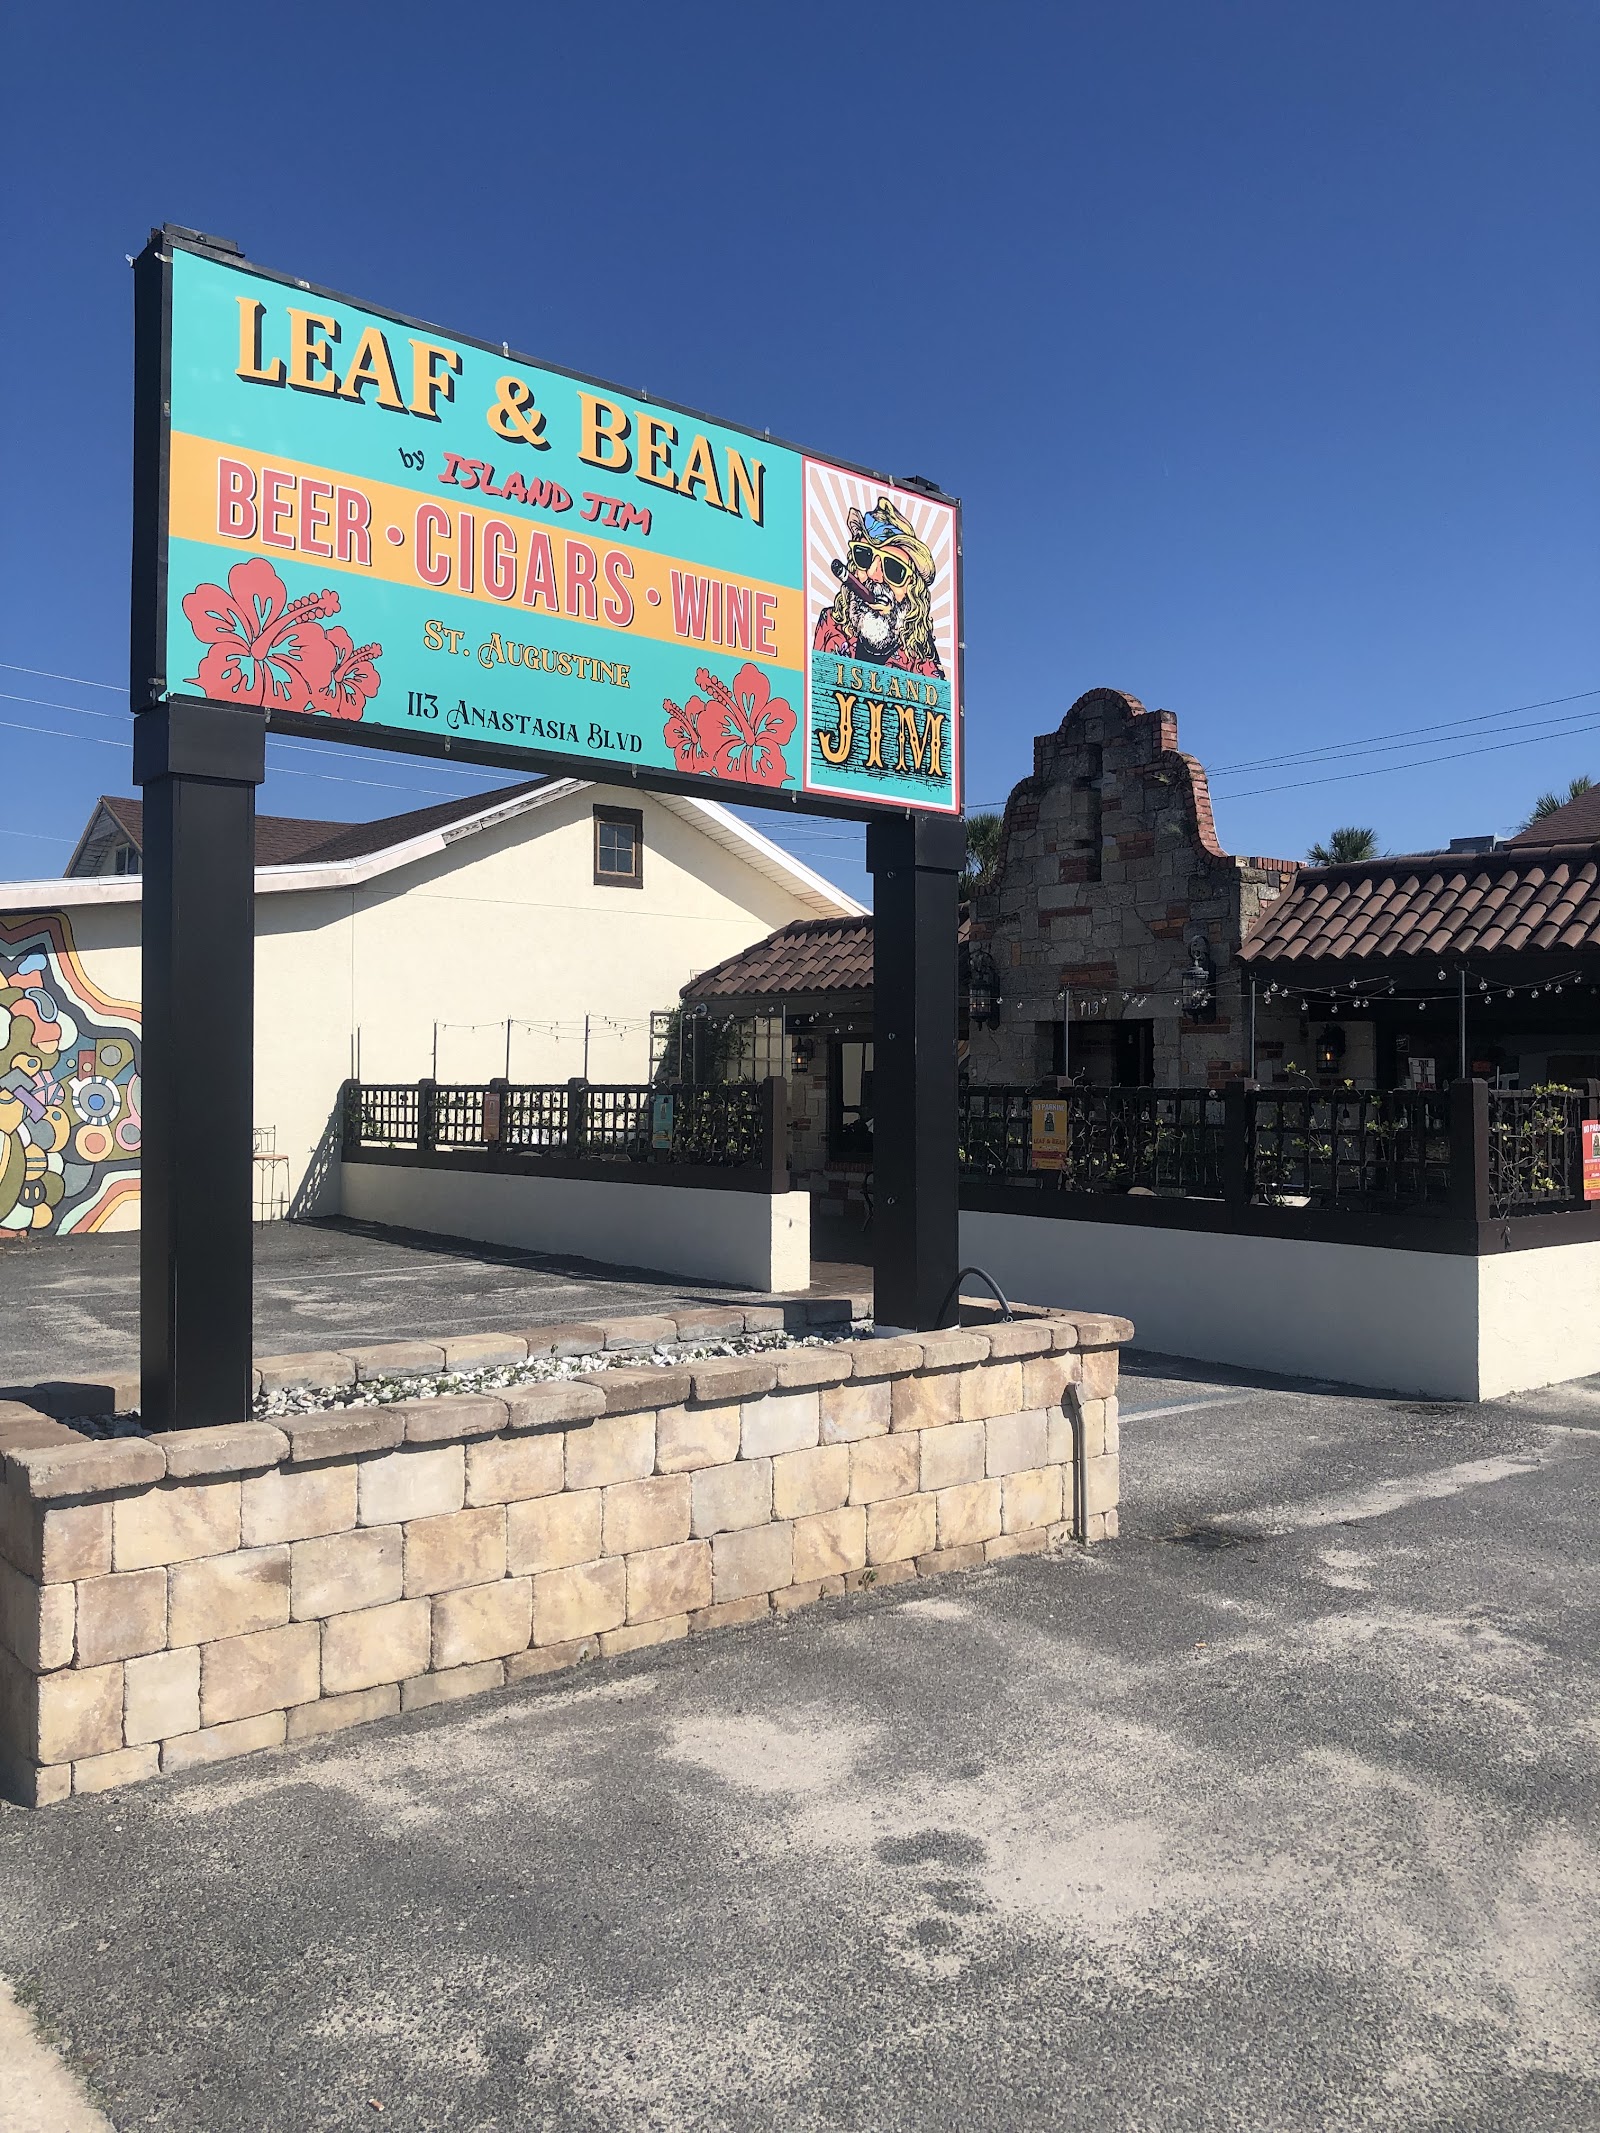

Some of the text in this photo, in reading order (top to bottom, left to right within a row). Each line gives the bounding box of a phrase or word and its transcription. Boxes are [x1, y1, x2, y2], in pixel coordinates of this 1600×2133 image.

[234, 296, 767, 529] LEAF & BEAN
[398, 447, 653, 536] by ISLAND JIM
[216, 456, 778, 658] BEER CIGARS WINE
[406, 691, 439, 719] 113
[835, 663, 939, 706] ISLAND
[817, 691, 946, 777] JIM
